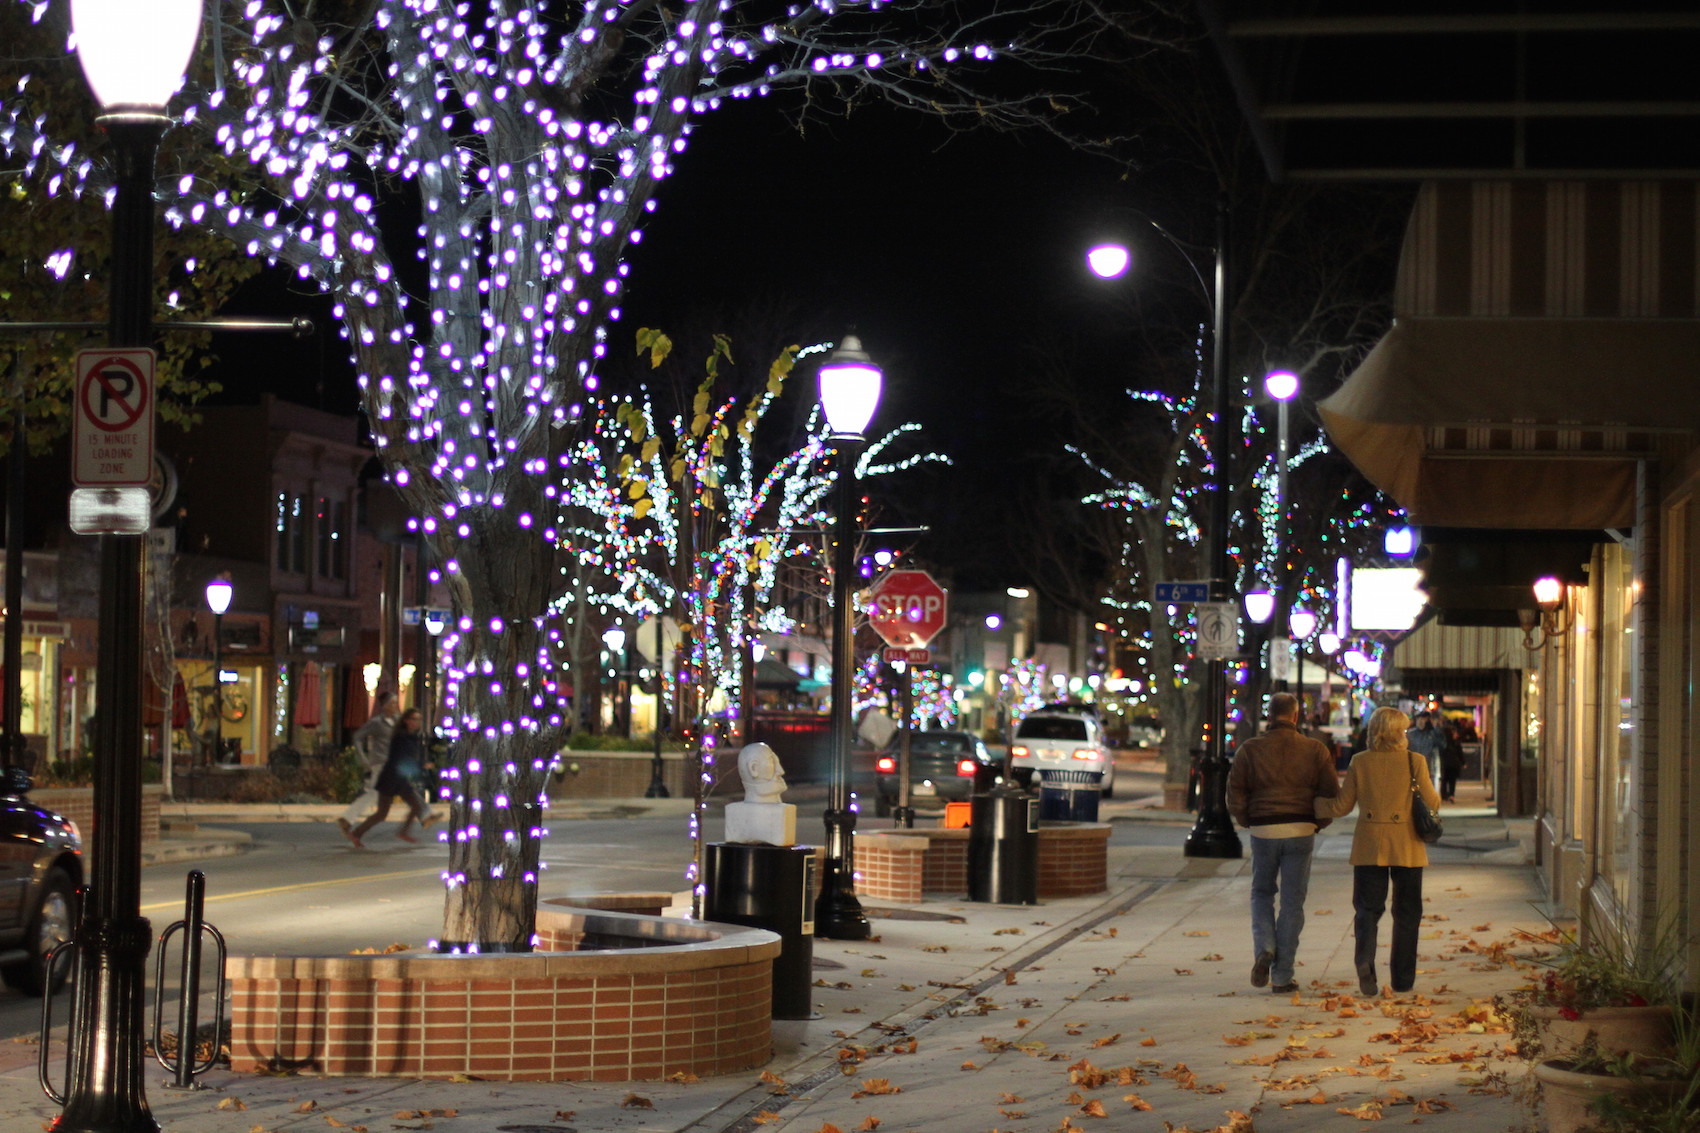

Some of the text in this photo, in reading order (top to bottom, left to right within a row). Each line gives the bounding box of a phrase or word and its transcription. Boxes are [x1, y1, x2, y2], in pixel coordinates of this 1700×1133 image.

[88, 434, 138, 445] 15 MINUTE
[92, 449, 133, 460] LOADING
[99, 463, 125, 474] ZONE
[876, 594, 940, 623] STOP
[909, 651, 927, 660] WAY
